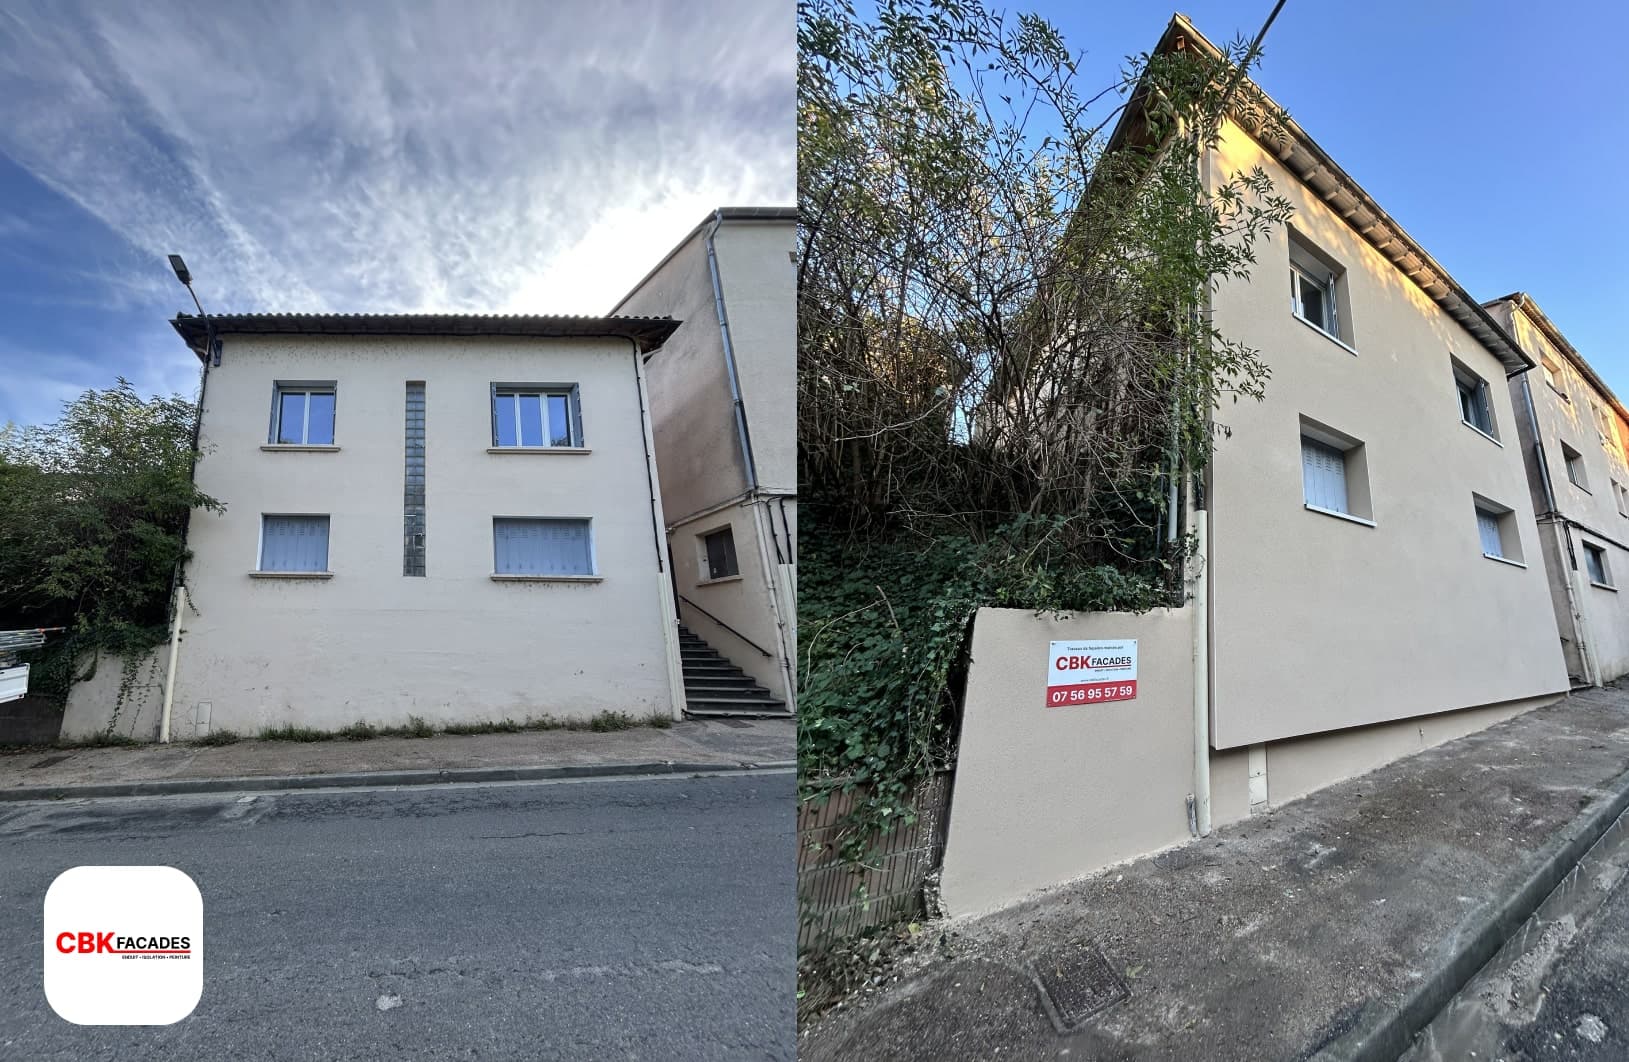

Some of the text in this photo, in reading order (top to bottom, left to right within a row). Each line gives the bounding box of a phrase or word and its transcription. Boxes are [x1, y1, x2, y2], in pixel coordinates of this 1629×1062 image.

[1056, 656, 1091, 670] CBK
[1091, 656, 1132, 666] FACADES
[1052, 685, 1133, 702] 07 56 95 57 59
